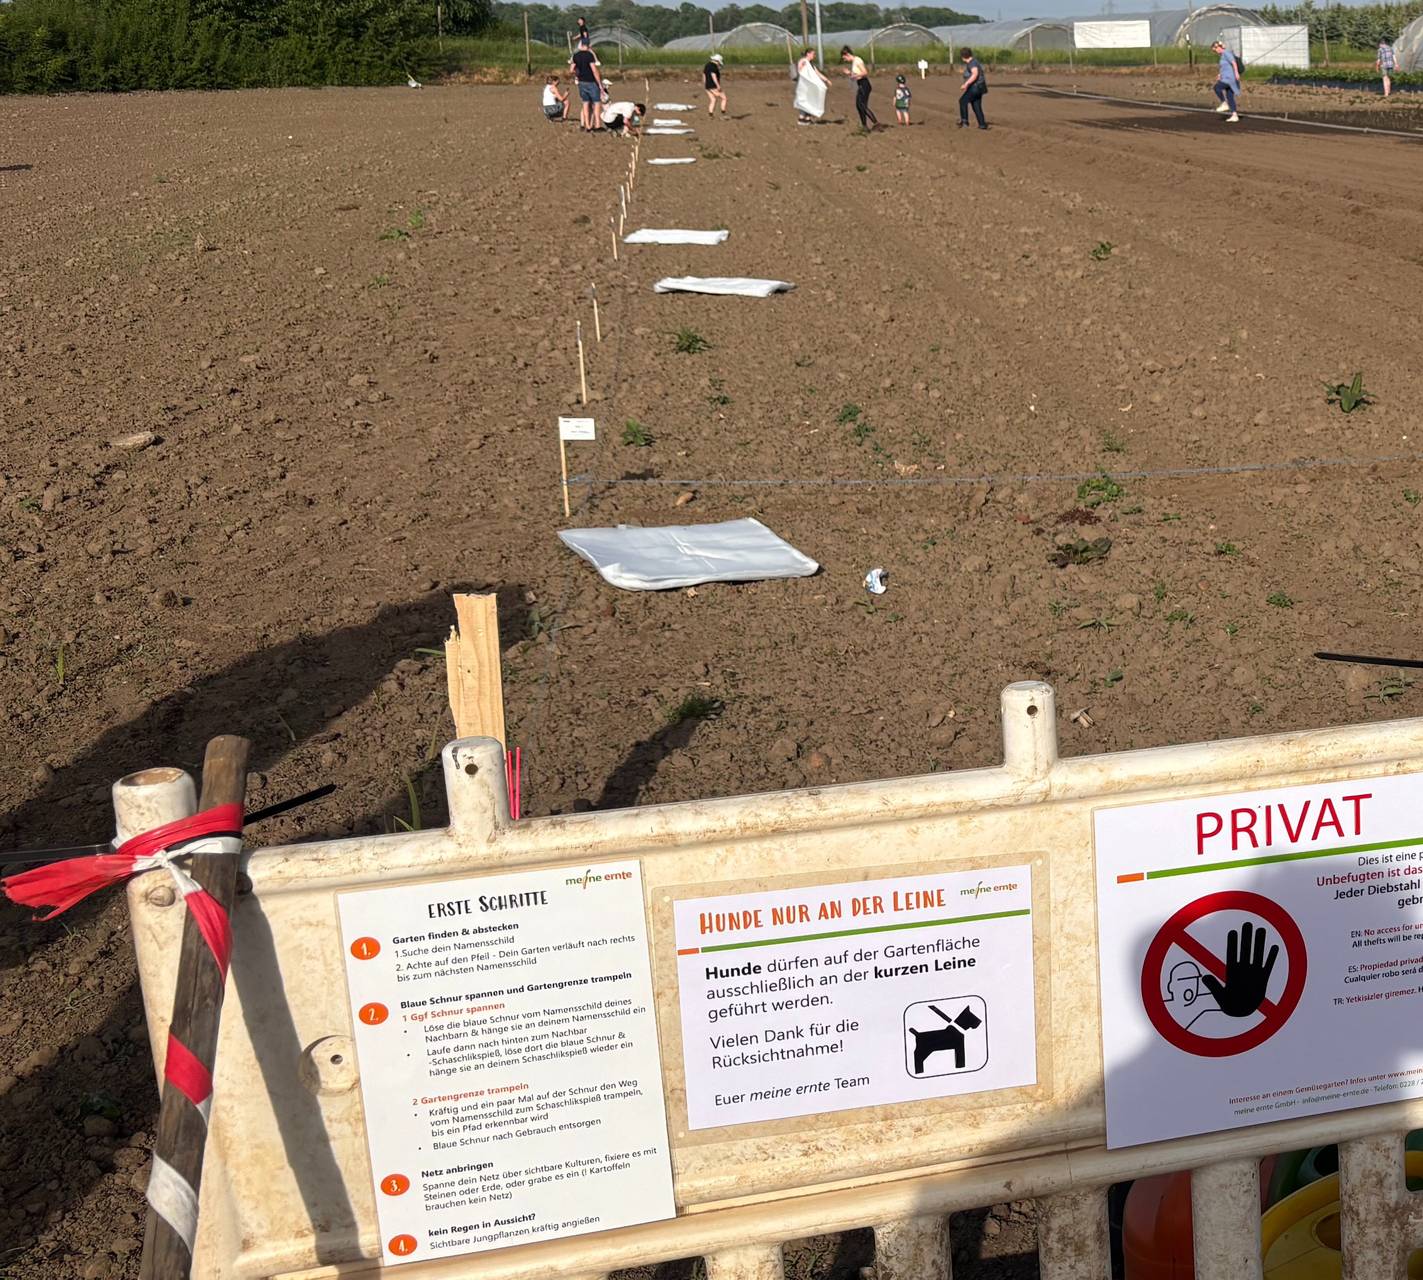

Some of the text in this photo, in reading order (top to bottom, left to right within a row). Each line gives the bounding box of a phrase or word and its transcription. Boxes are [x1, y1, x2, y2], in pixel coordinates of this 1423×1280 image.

[1197, 794, 1373, 855] PRIVAT
[1358, 856, 1379, 866] Dies
[1381, 854, 1393, 863] ist
[1395, 851, 1416, 861] eine
[604, 871, 632, 881] ernte
[1316, 871, 1384, 886] Unbefugten
[1387, 868, 1400, 877] ist
[1403, 864, 1422, 875] das
[993, 883, 1018, 891] ernte
[1334, 887, 1364, 899] Jeder
[1367, 878, 1420, 895] Diebstahl
[427, 890, 548, 918] ERSTE SCHRITTE
[699, 888, 945, 934] HUNDE NUR AN DER LEINE
[392, 935, 425, 944] Garten
[427, 930, 458, 940] finden
[472, 923, 518, 934] abstecken
[1350, 930, 1363, 938] EN:
[1376, 926, 1400, 935] access
[1402, 923, 1413, 931] for
[1352, 940, 1362, 948] All
[1364, 937, 1386, 947] thefts
[1387, 934, 1400, 943] will
[1402, 932, 1413, 941] be
[361, 943, 371, 956] 1.
[705, 936, 979, 980] Hunde dürfen auf der Gartenfläche
[706, 956, 976, 999] ausschließlich an der kurzen Leine
[400, 971, 631, 1008] Blaue Schnur spannen und Gartengrenze trampeln
[369, 1008, 379, 1021] 2.
[402, 1003, 505, 1022] 1 Ggf Schnur spannen
[708, 993, 832, 1023] geführt werden.
[709, 1018, 859, 1049] Vielen Dank für die
[712, 1039, 843, 1069] Rücksichtnahme!
[420, 1089, 484, 1104] Gartengrenze
[487, 1082, 529, 1094] trampeln
[714, 1076, 869, 1106] Euer meine ernte Team
[421, 1162, 493, 1178] Netz anbringen
[390, 1180, 400, 1192] 3.
[428, 1212, 535, 1236] kein Regen in Aussicht?
[399, 1240, 408, 1252] 4.
